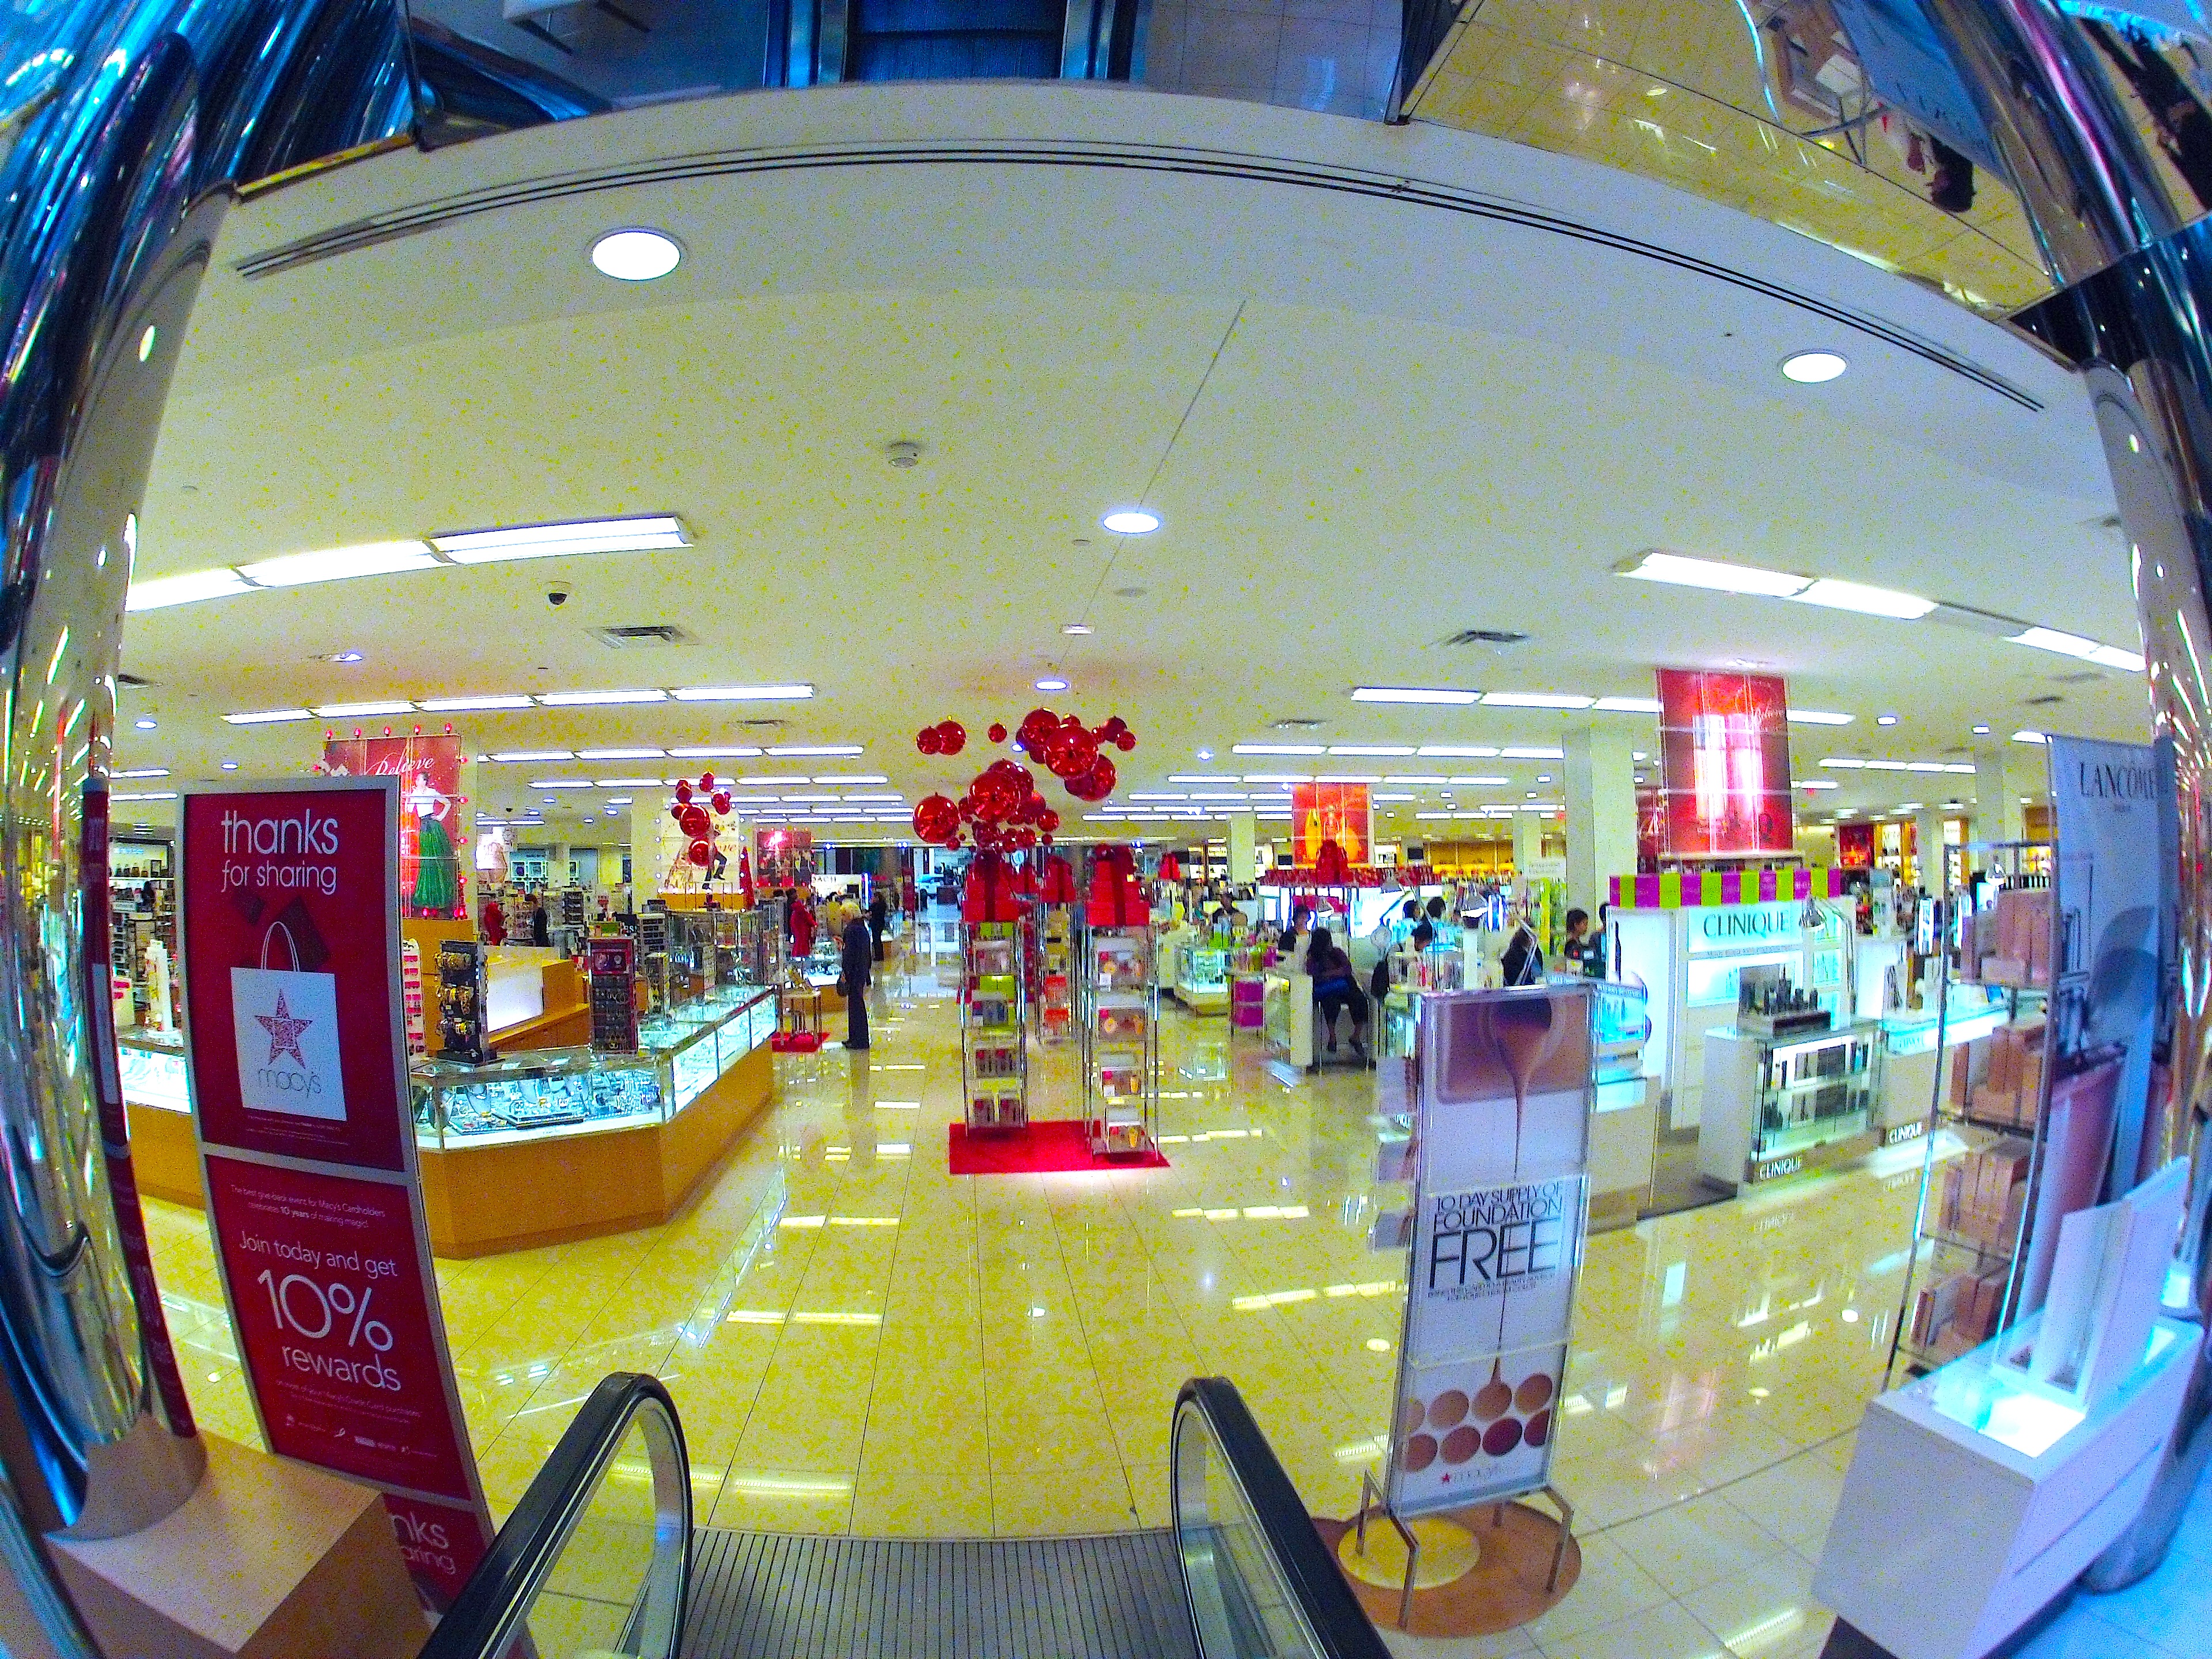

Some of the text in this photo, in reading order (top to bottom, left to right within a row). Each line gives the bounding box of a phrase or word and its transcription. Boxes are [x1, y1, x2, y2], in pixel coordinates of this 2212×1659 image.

[221, 808, 339, 854] thanks
[221, 859, 336, 895] for sharing
[1703, 910, 1790, 938] CLINIQUE
[1759, 1156, 1802, 1180] CLINIQUE
[281, 1206, 290, 1215] 10
[291, 1210, 310, 1219] years
[318, 1199, 341, 1213] Macy's
[1433, 1195, 1563, 1233] FOUNDATION
[1437, 1181, 1560, 1213] 10 DAY SUPPLY OF
[239, 1231, 398, 1279] Join today and get
[1429, 1216, 1562, 1289] FREE
[257, 1269, 394, 1351] 10%
[282, 1346, 402, 1392] rewards
